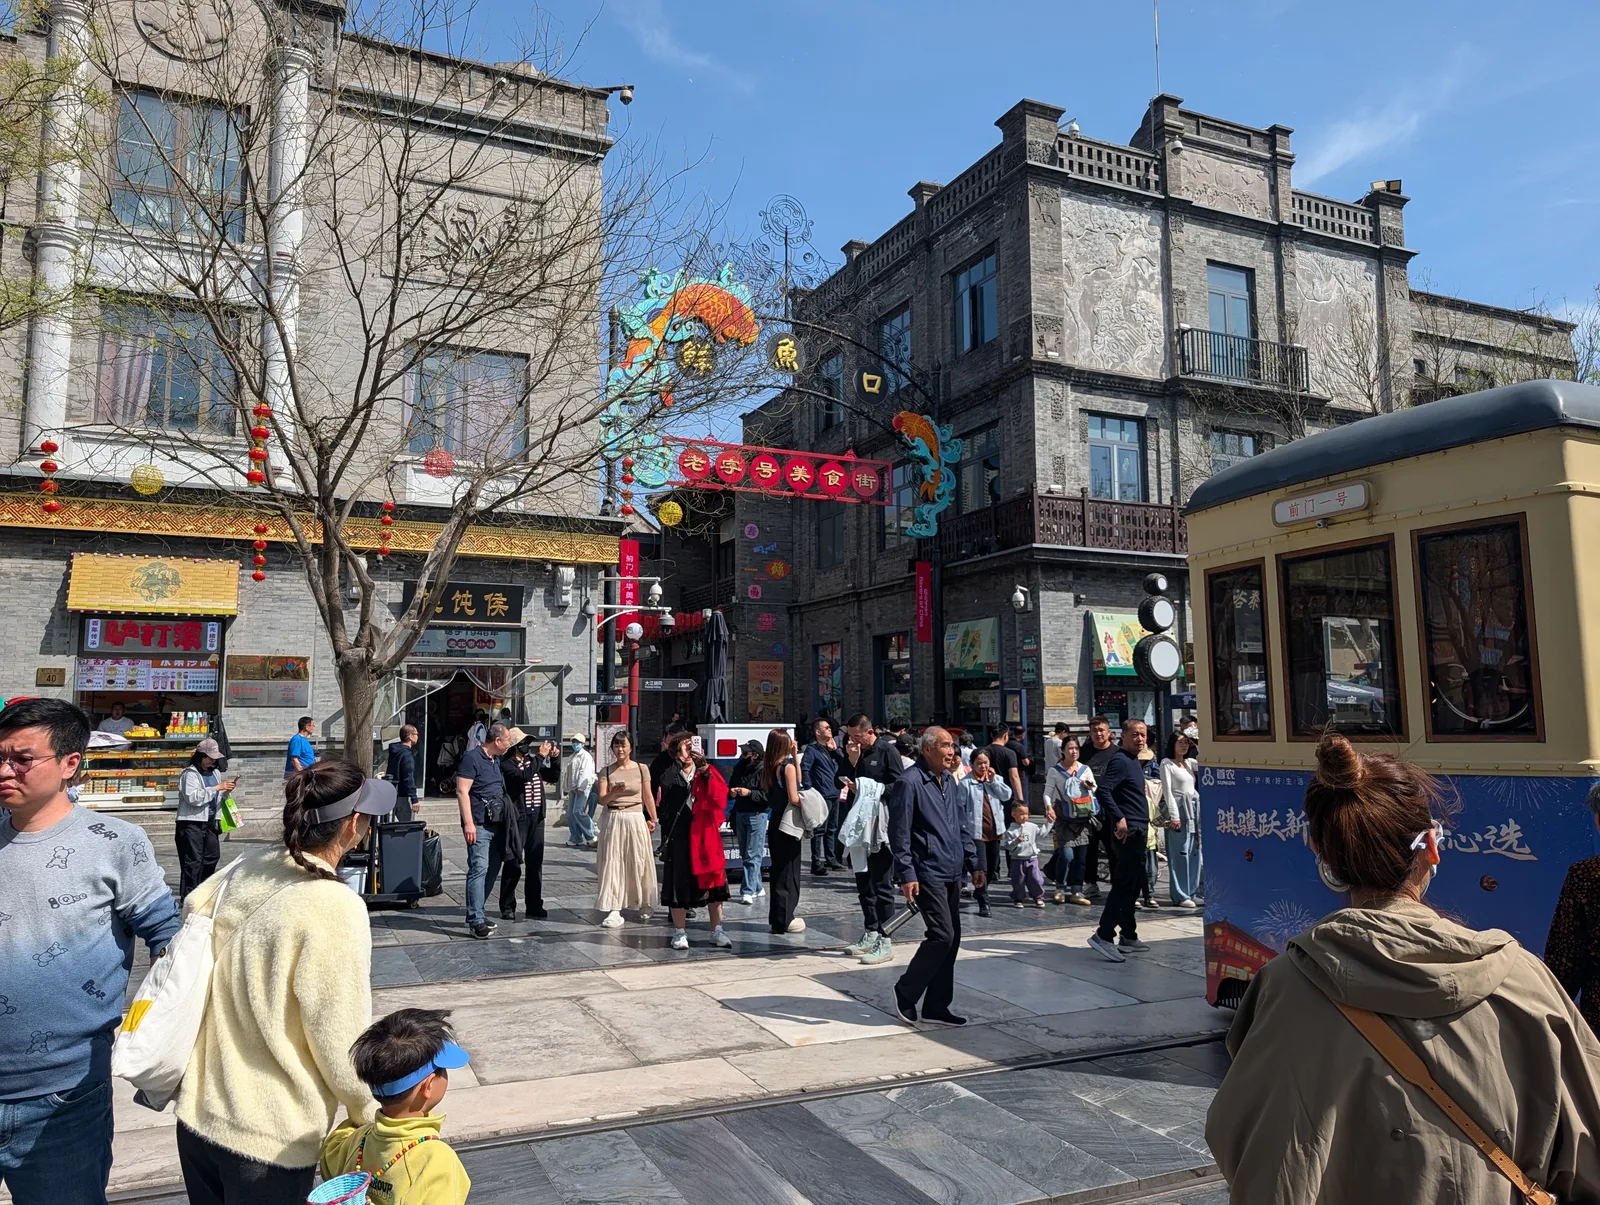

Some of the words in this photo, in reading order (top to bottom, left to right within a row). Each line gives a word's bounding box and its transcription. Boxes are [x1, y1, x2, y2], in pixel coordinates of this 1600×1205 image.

[683, 455, 877, 490] 老字号美食街
[1288, 491, 1348, 517] 前门一号
[104, 620, 203, 651] 驴打滚
[46, 674, 57, 683] 40
[1216, 768, 1236, 780] 首农
[87, 822, 118, 841] BEAR
[81, 979, 107, 1001] BEAR
